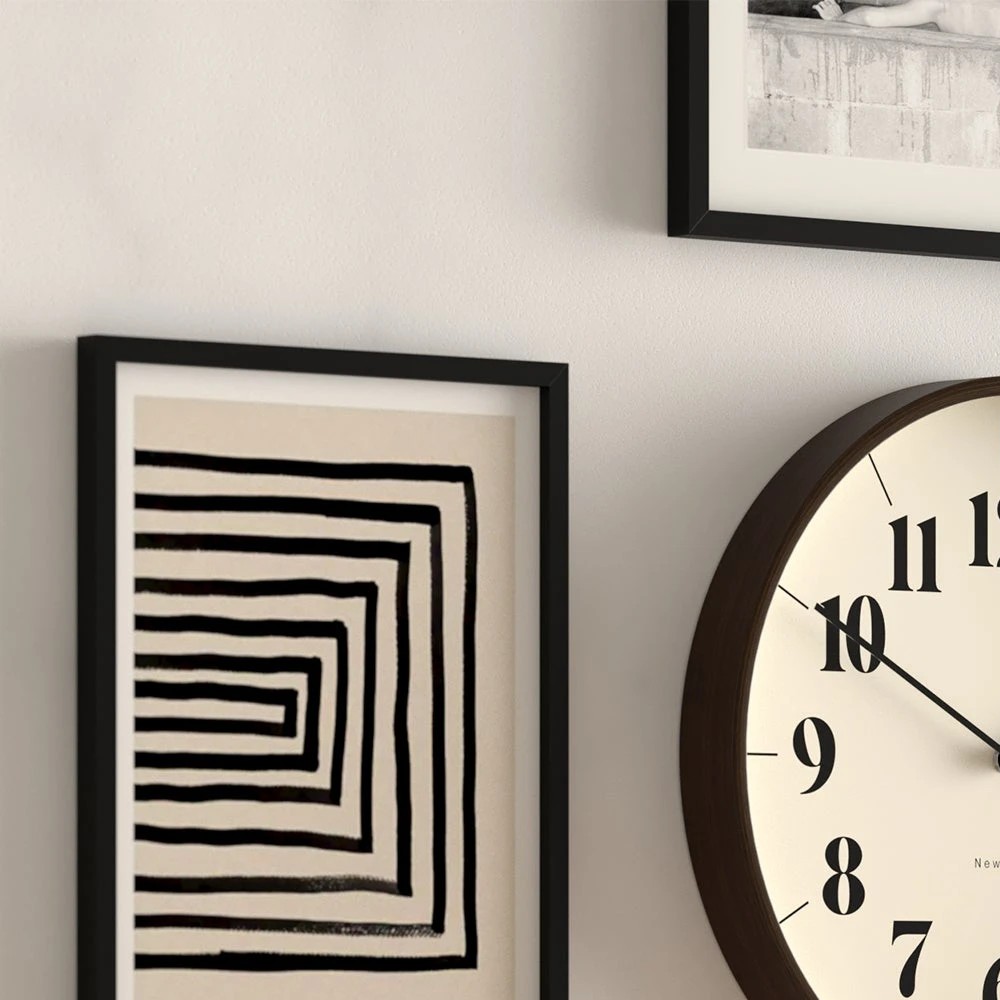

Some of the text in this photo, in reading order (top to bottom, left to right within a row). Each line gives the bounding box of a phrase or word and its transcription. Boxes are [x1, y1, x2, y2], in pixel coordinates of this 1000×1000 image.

[887, 515, 942, 593] 11
[819, 594, 886, 674] 10
[792, 716, 836, 795] 9
[822, 836, 866, 916] 8
[891, 920, 933, 998] 7
